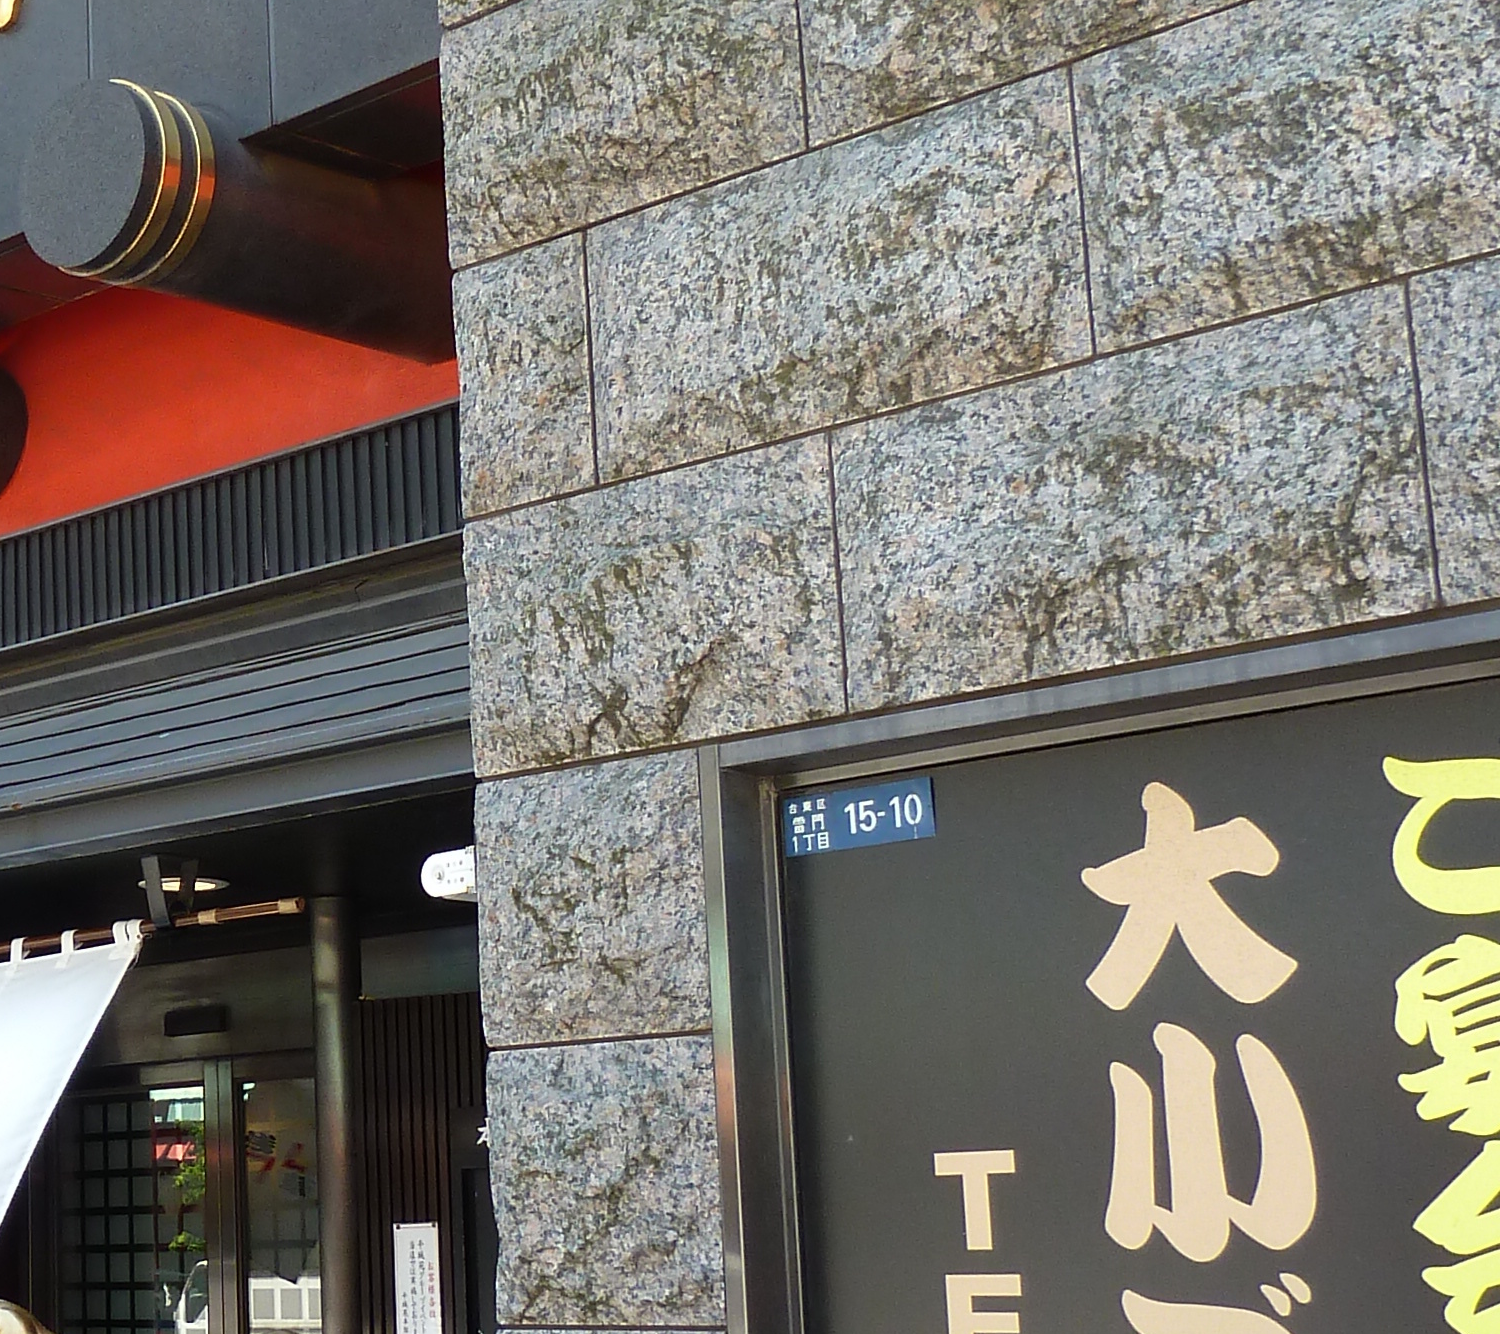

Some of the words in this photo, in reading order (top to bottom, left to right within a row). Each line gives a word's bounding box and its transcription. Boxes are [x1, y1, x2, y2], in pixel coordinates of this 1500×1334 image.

[792, 813, 825, 834] 雷門
[843, 793, 923, 835] 15-10
[791, 831, 830, 853] 1丁目
